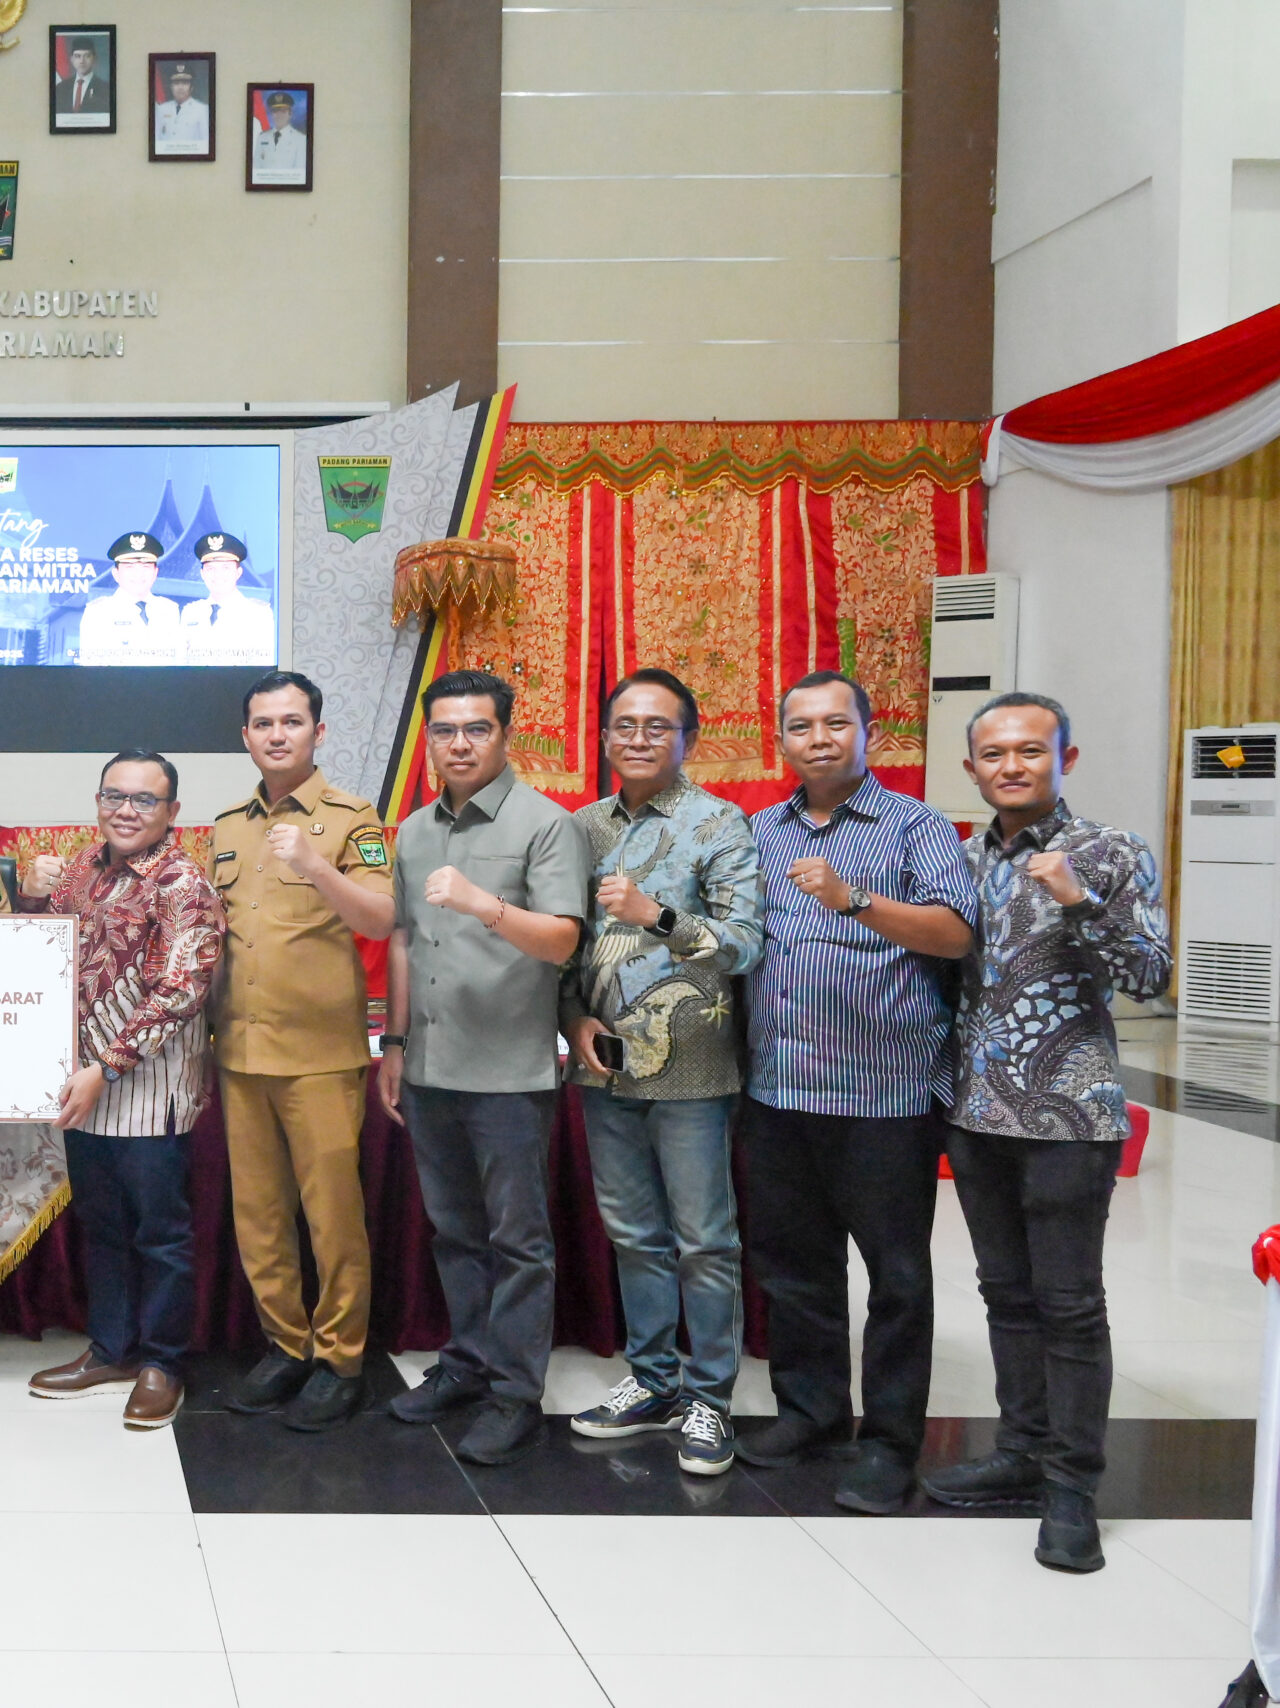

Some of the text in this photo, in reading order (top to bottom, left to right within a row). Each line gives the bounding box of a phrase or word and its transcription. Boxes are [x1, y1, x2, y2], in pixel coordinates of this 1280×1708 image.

[19, 547, 79, 562] RESES
[34, 563, 97, 578] MITRA
[3, 1012, 18, 1025] RI
